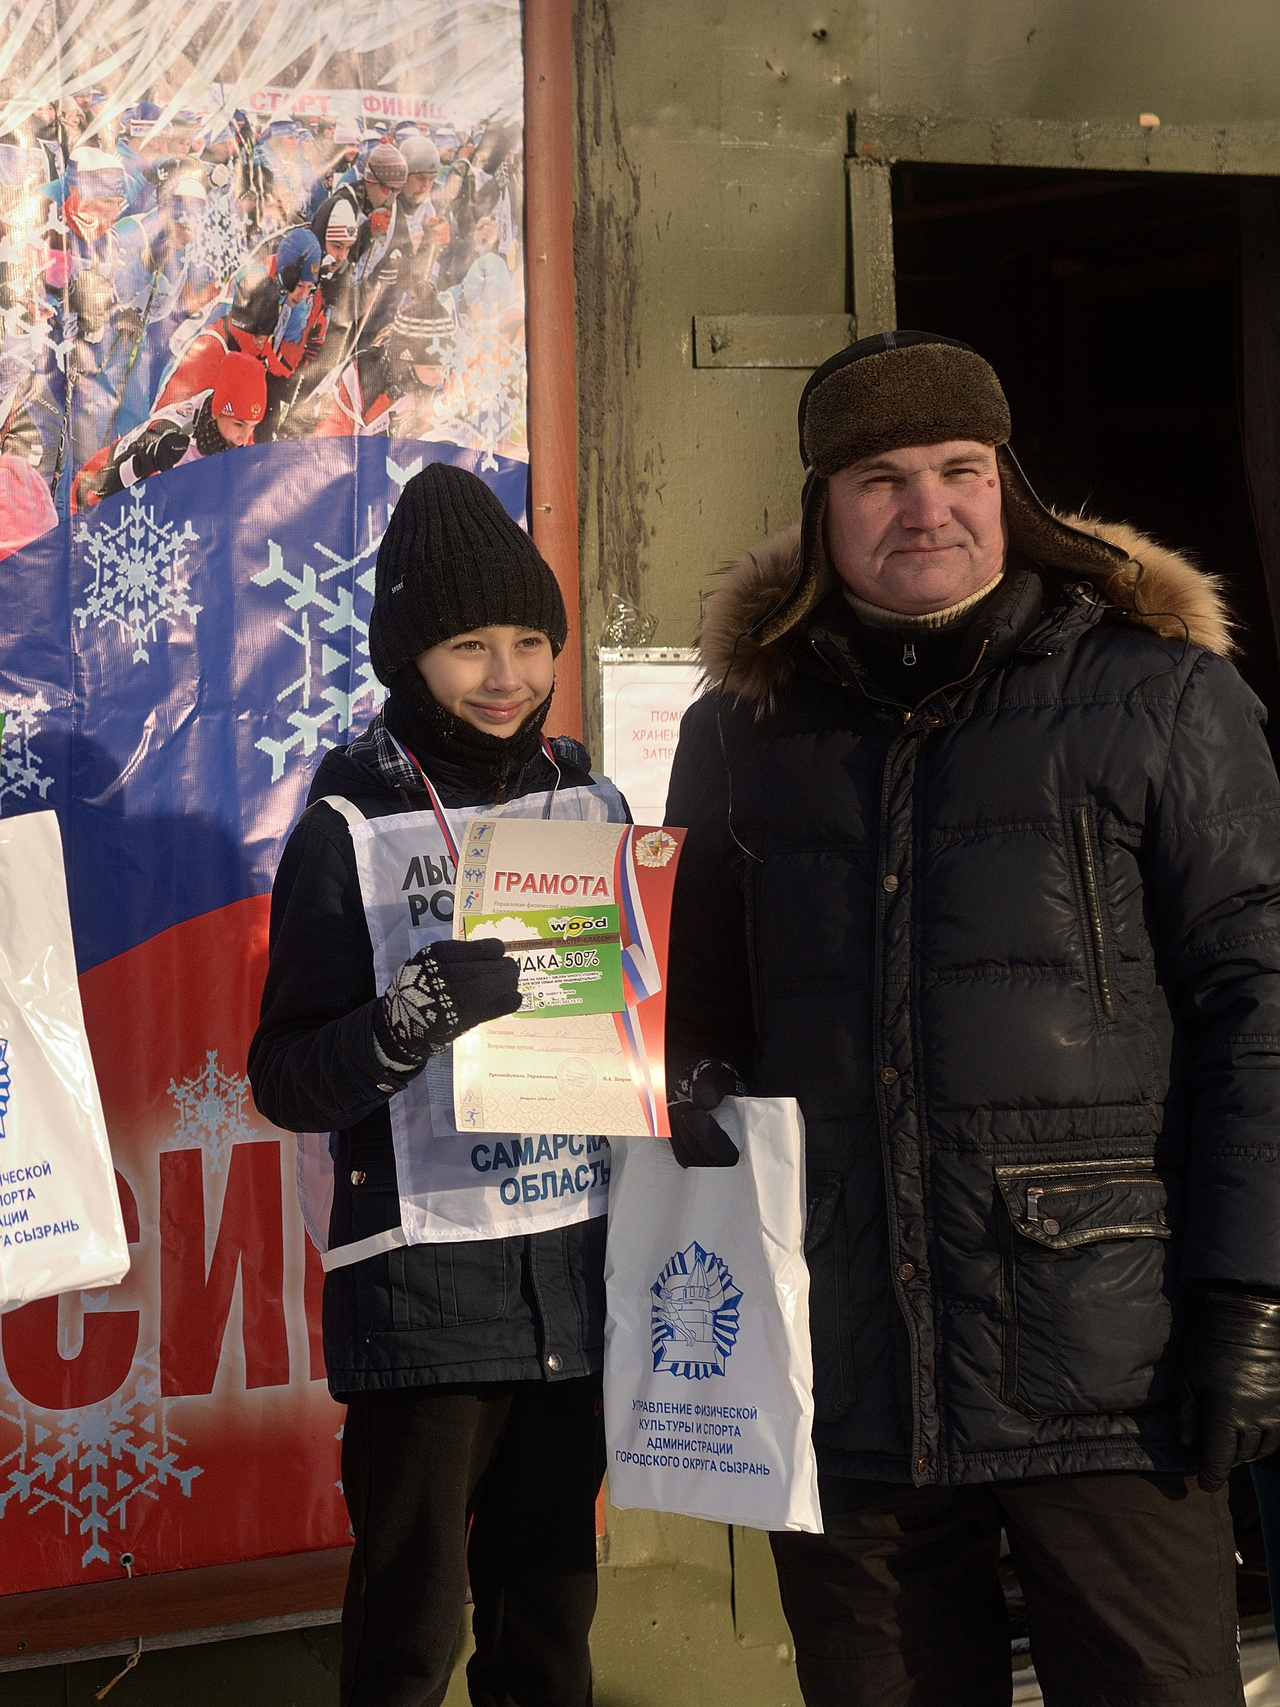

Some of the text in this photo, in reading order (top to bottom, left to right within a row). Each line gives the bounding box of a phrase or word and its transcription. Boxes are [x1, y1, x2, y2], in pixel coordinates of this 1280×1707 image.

[632, 729, 679, 741] ХРАНЕН
[642, 748, 674, 760] ЗАПР
[401, 855, 457, 891] ЛЫ
[493, 871, 611, 898] ГРАМОТА
[493, 900, 526, 908] Управление
[550, 917, 608, 932] wood
[564, 950, 600, 968] 50%
[500, 1159, 611, 1206] ОБЛАСТЬ
[14, 1219, 80, 1244] СЫЗРАНЬ
[632, 1399, 758, 1420] УПРАВЛЕНИЕ ФИЗИЧЕСКОЙ
[639, 1418, 742, 1438] КУЛЬТУРЫ И СПОРТА
[646, 1437, 734, 1456] АДМИНИСТРАЦИИ
[615, 1450, 770, 1476] ГОРОДСКОГО ОКРУГА СЫЗРАНЬ
